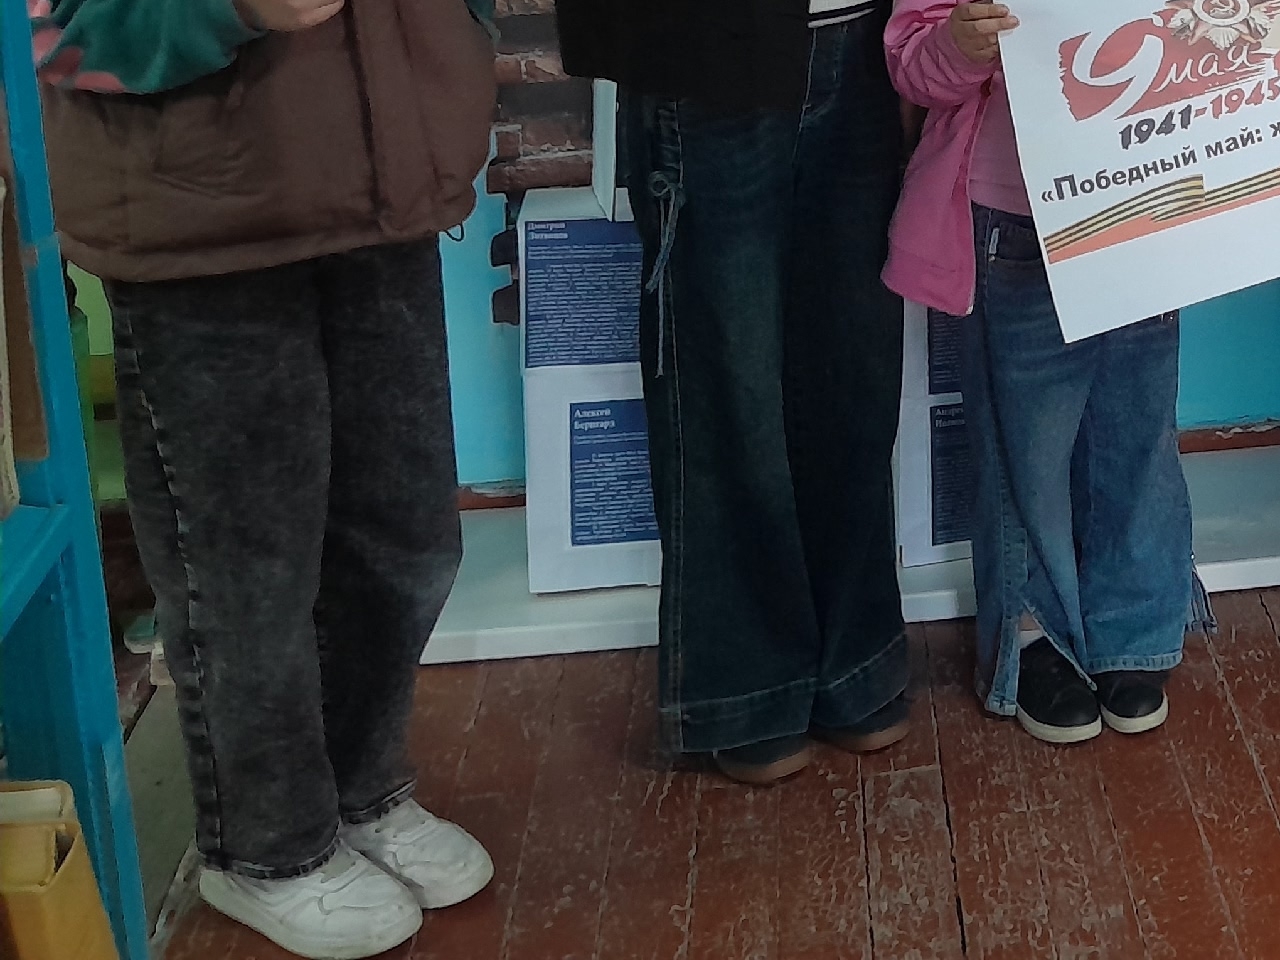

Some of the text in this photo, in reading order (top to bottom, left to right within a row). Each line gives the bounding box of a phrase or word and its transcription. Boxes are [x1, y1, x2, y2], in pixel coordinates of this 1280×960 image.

[1153, 43, 1260, 93] мая
[1040, 145, 1198, 204] «Победный
[1204, 127, 1263, 158] май:
